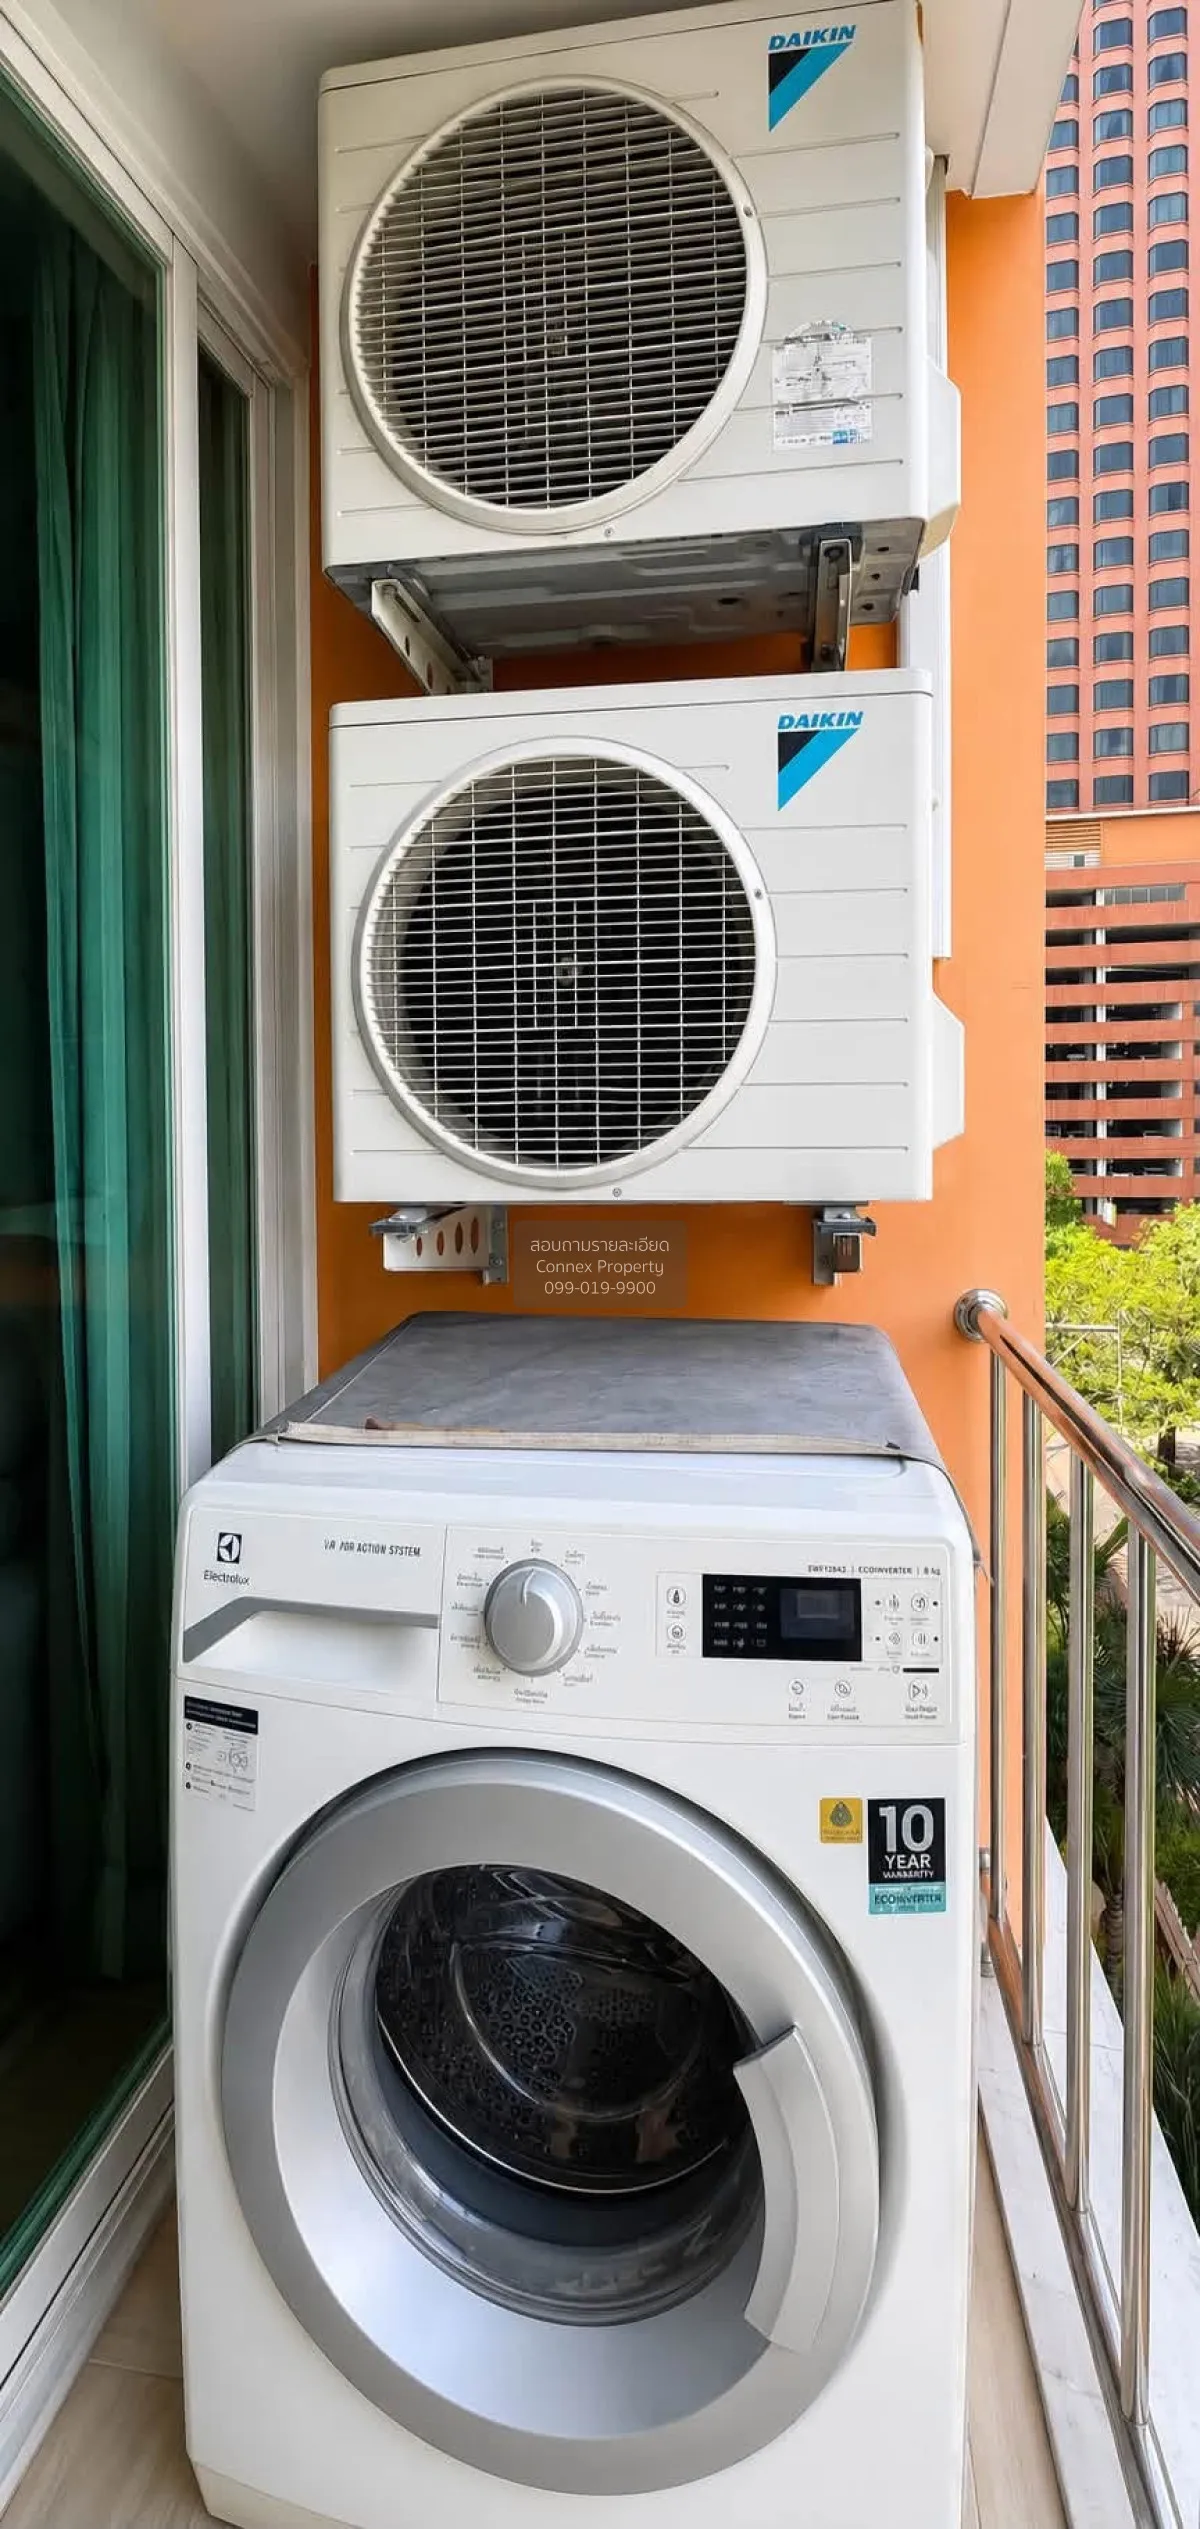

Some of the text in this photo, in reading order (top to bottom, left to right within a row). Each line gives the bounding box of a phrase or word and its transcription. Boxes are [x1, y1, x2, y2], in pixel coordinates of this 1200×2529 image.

[768, 24, 857, 50] DAIKIN
[777, 710, 864, 730] DAIKIN
[356, 1542, 387, 1555] ACTION
[388, 1544, 422, 1558] SYSTEM
[203, 1569, 250, 1586] Electrolux
[879, 1804, 935, 1853] 10
[884, 1853, 932, 1870] YEAR
